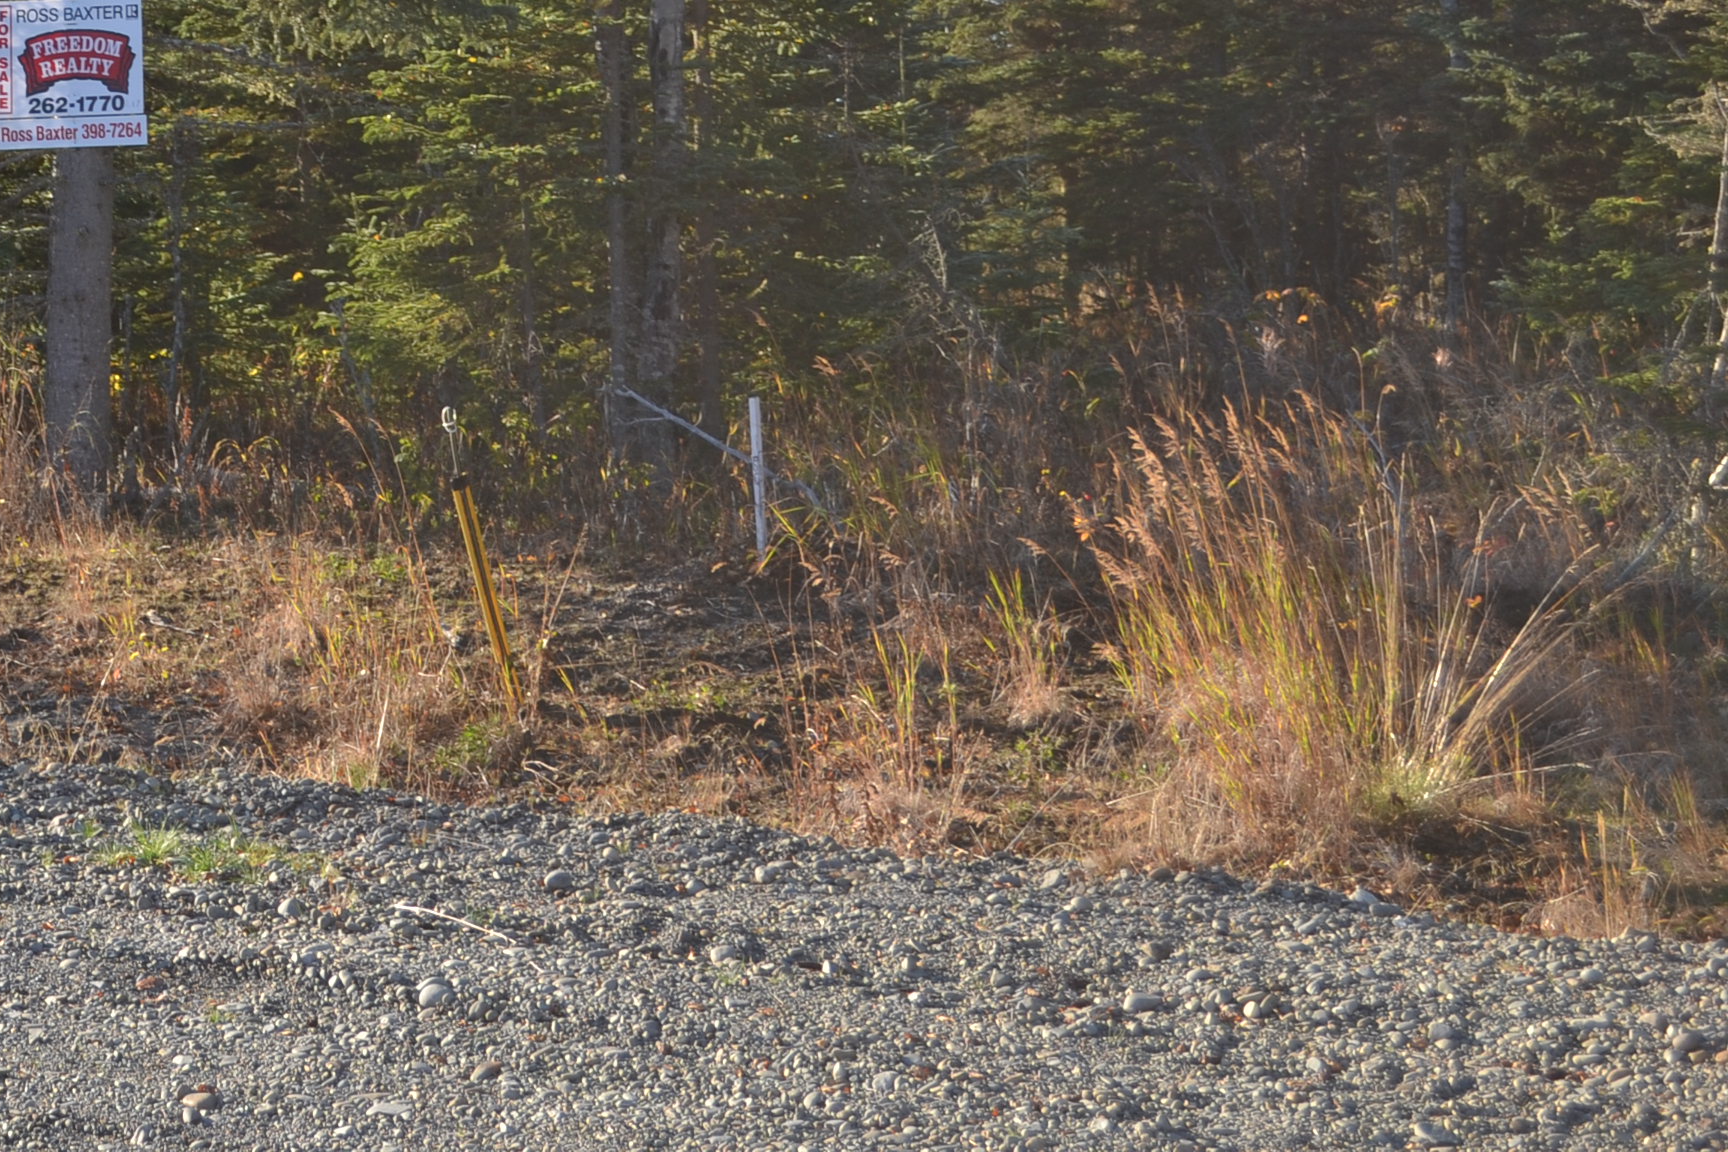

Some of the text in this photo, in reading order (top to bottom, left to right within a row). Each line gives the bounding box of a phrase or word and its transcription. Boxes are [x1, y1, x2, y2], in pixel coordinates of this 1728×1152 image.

[16, 7, 59, 23] ROSS
[63, 5, 123, 21] BAXTER
[29, 35, 123, 59] FREEDOM
[38, 57, 114, 79] REALTY
[28, 95, 125, 114] 262-1770
[1, 122, 142, 143] Ross Baxter 398-7264
